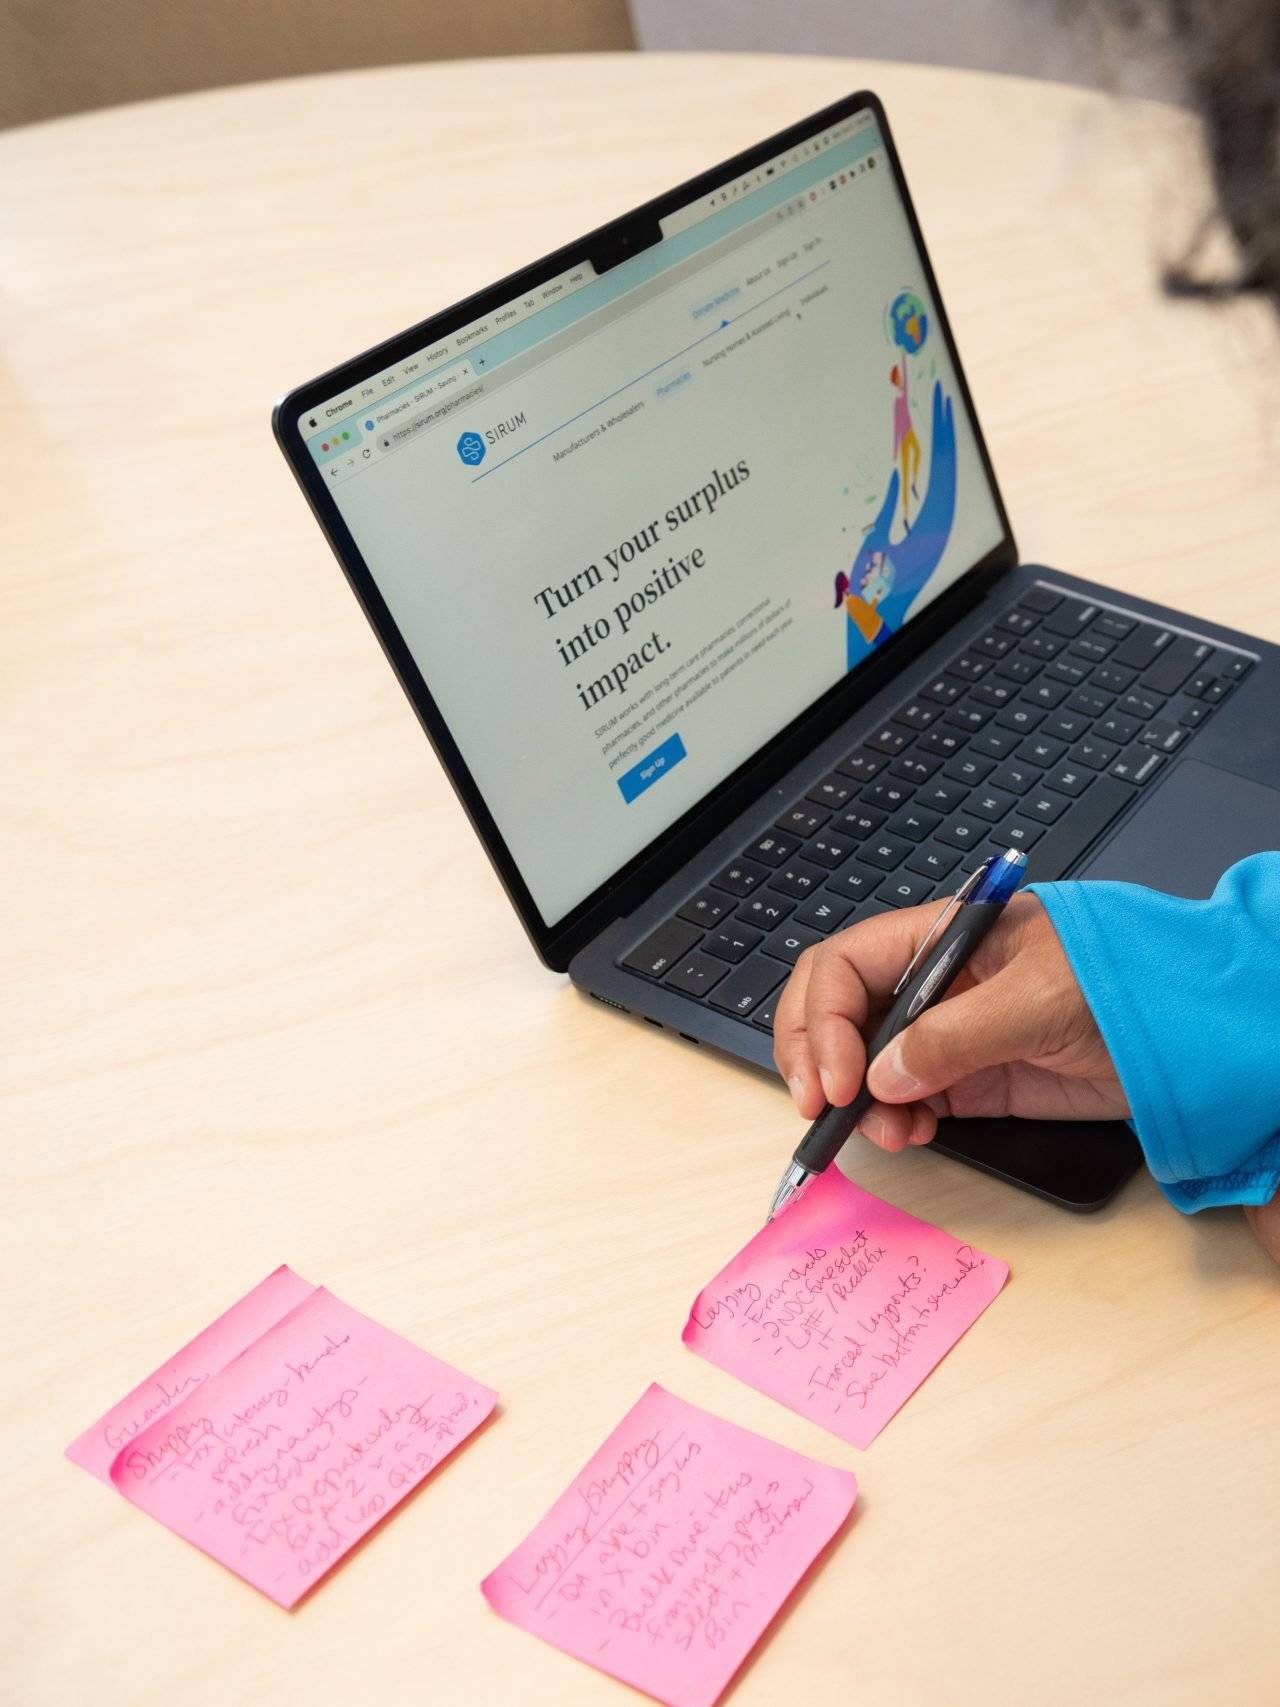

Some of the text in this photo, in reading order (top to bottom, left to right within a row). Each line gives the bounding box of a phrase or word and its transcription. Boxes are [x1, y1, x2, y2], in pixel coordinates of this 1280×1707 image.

[325, 399, 353, 418] Chrome
[381, 375, 396, 387] Edit
[403, 364, 419, 375] View
[426, 347, 449, 362] History
[456, 325, 489, 346] Bookmarks
[495, 310, 517, 325] Profiles
[485, 411, 527, 445] SIRUM
[552, 429, 601, 462] Manufacturers
[533, 460, 750, 619] Turn your surplus
[555, 548, 705, 667] into positive
[576, 632, 672, 711] impact.
[766, 908, 779, 917] 2
[798, 877, 811, 886] 3
[830, 847, 841, 856] 4
[858, 819, 872, 828] 5
[888, 791, 900, 799] 6
[915, 764, 927, 772] 7
[897, 885, 911, 895] D
[927, 855, 938, 865] F
[955, 827, 969, 836] G
[982, 798, 997, 809] H
[1012, 772, 1022, 781] J
[1036, 746, 1048, 755] K
[1010, 773, 1076, 838] B N M
[737, 996, 752, 1008] tab
[785, 938, 800, 948] Q
[815, 905, 831, 917] W
[848, 876, 862, 885] E
[878, 846, 892, 856] R
[907, 817, 919, 826] T
[935, 790, 947, 798] Y
[962, 763, 976, 773] U
